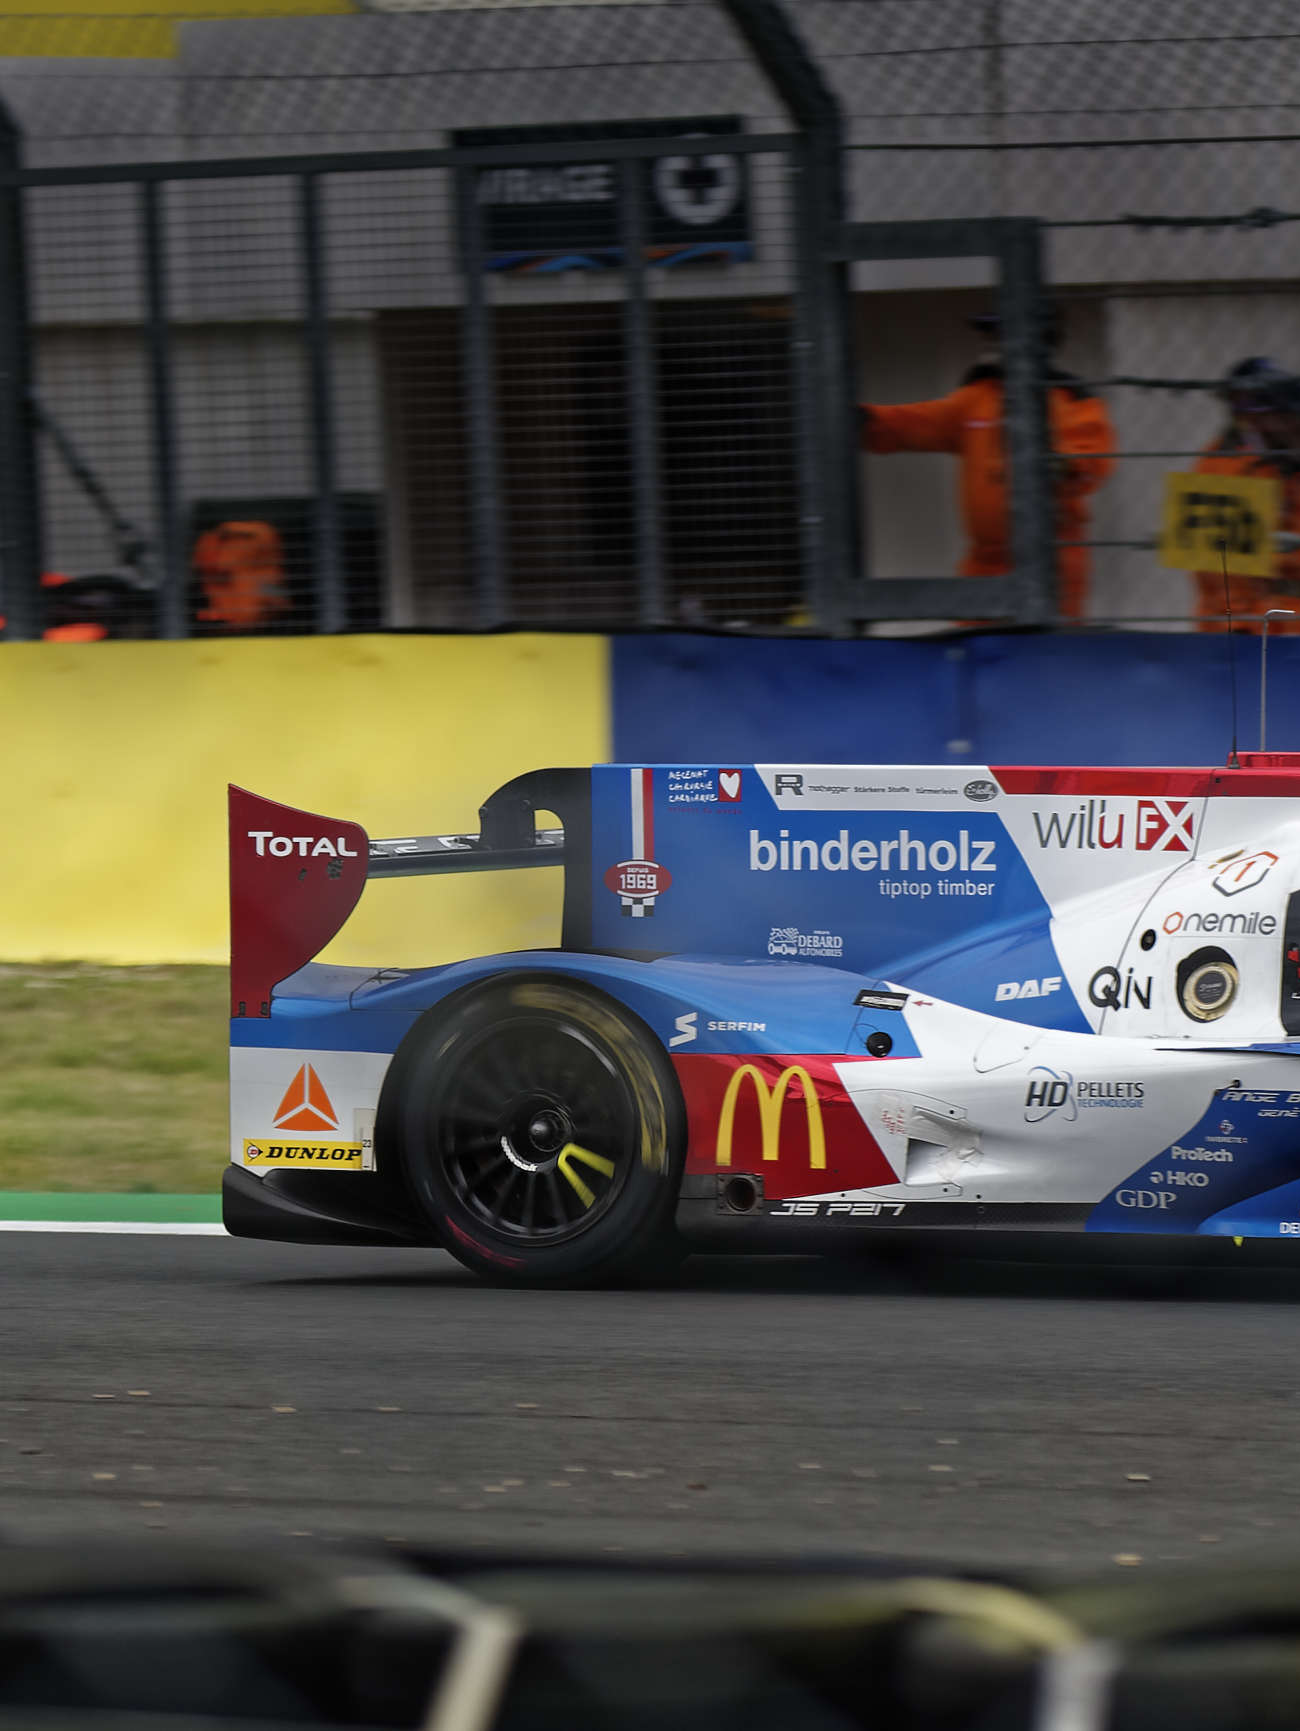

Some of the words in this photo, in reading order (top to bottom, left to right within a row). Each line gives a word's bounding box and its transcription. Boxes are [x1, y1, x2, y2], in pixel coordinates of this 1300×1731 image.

[1032, 799, 1124, 850] wilu
[1136, 799, 1194, 852] FX
[247, 830, 358, 858] TOTAL
[750, 829, 997, 871] binderholz
[619, 874, 657, 889] 1969
[878, 879, 932, 899] tiptop
[938, 879, 995, 896] timber
[1163, 911, 1277, 935] onemile
[798, 935, 844, 948] DEBARD
[995, 976, 1062, 1002] DAF
[707, 1020, 767, 1032] SERFIM
[1025, 1081, 1070, 1107] HD
[1077, 1081, 1145, 1099] PELLETS
[1077, 1098, 1145, 1109] TECHNOLOGIE
[265, 1147, 362, 1161] DUNLOP
[1171, 1146, 1234, 1162] ProTech
[1167, 1171, 1209, 1187] HKO
[1116, 1190, 1177, 1210] GDP
[769, 1203, 821, 1216] JS
